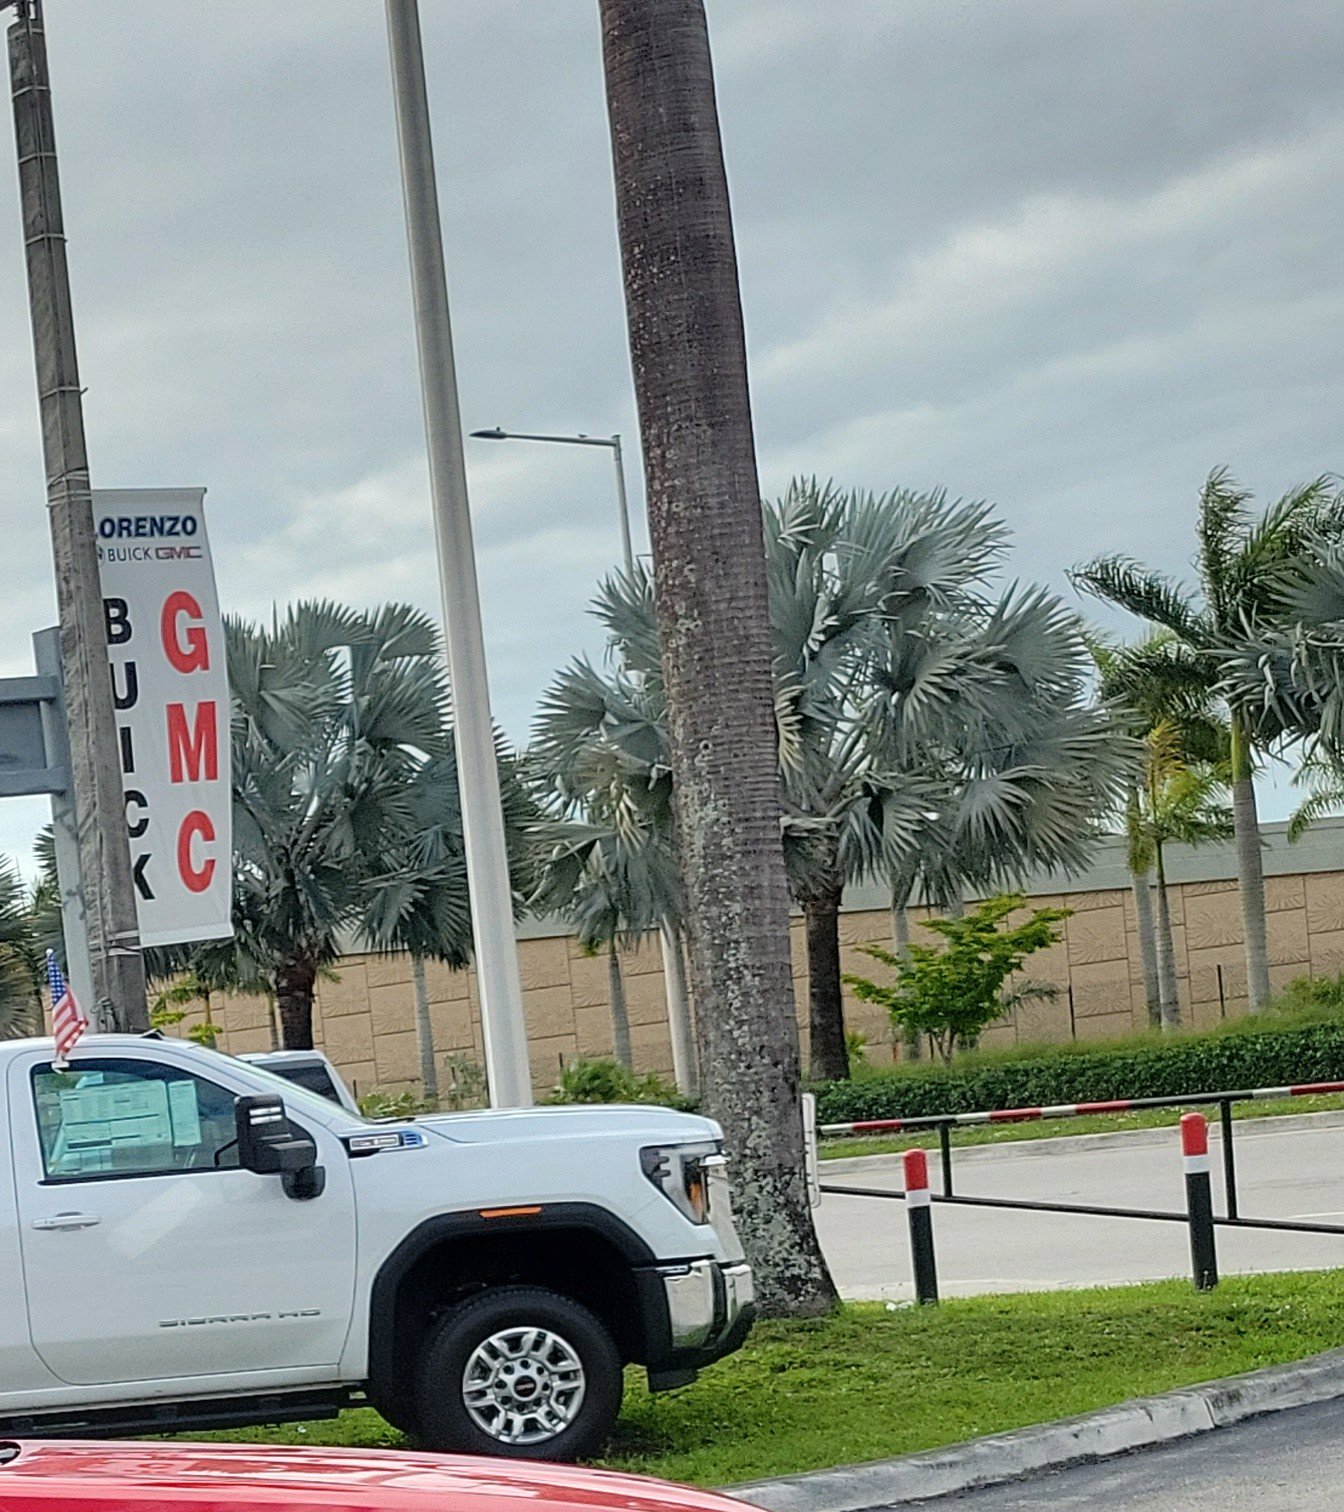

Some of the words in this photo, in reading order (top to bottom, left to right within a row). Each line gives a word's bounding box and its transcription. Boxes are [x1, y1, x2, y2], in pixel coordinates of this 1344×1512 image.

[95, 515, 198, 539] ORENZO
[107, 546, 152, 562] BUICK
[155, 546, 203, 560] GMC
[161, 590, 219, 893] GMC
